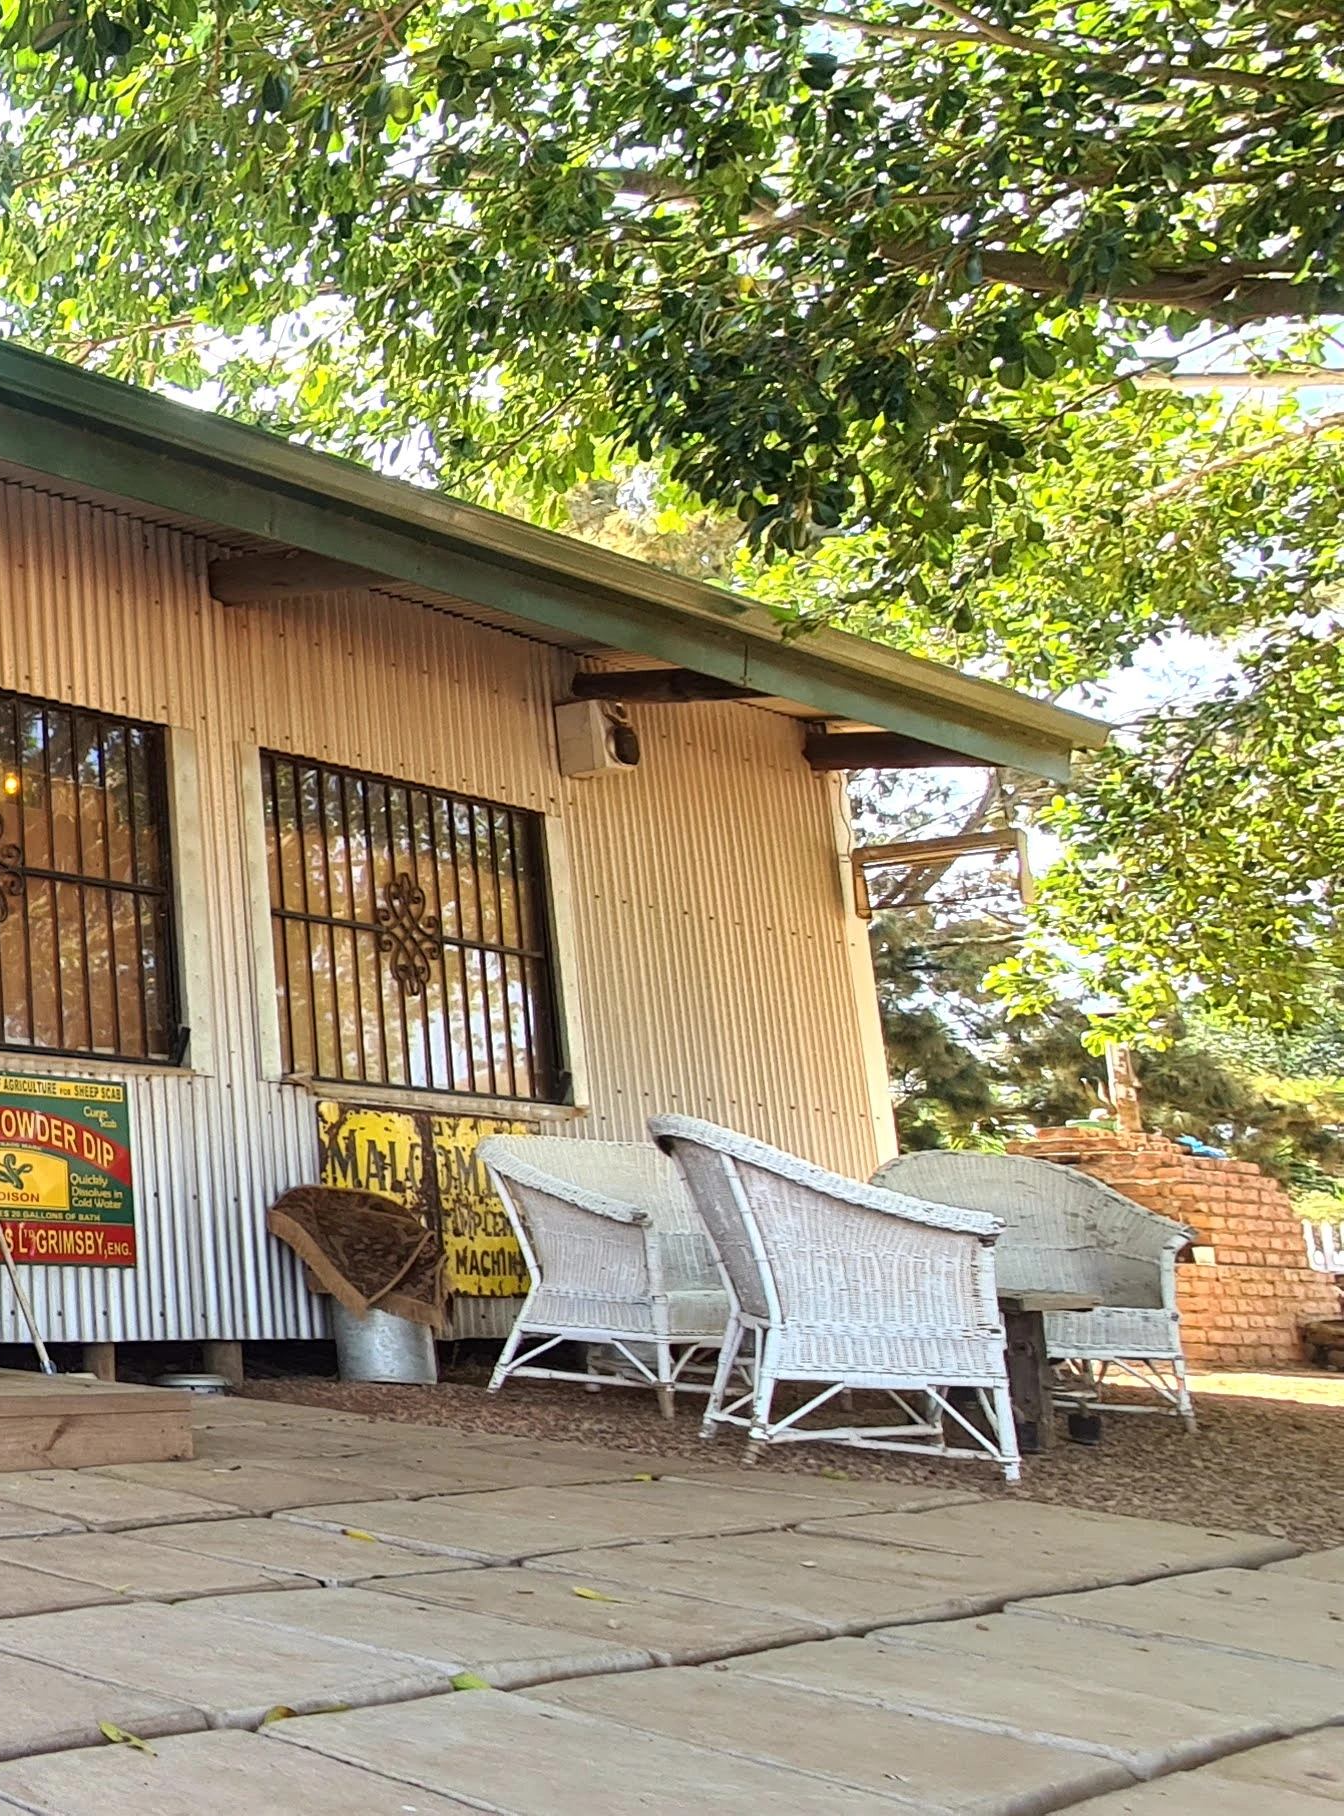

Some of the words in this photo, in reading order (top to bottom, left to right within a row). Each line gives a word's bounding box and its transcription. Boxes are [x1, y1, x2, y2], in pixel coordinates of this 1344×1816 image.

[4, 1078, 56, 1095] AGRICULTURE
[74, 1085, 99, 1098] SHEEP
[101, 1087, 121, 1100] SCAB
[82, 1131, 114, 1168] DIP
[70, 1173, 108, 1188] Quickly
[71, 1197, 93, 1208] Cold
[23, 1211, 64, 1220] GALLONS
[65, 1212, 76, 1221] OF
[78, 1213, 101, 1221] BATH
